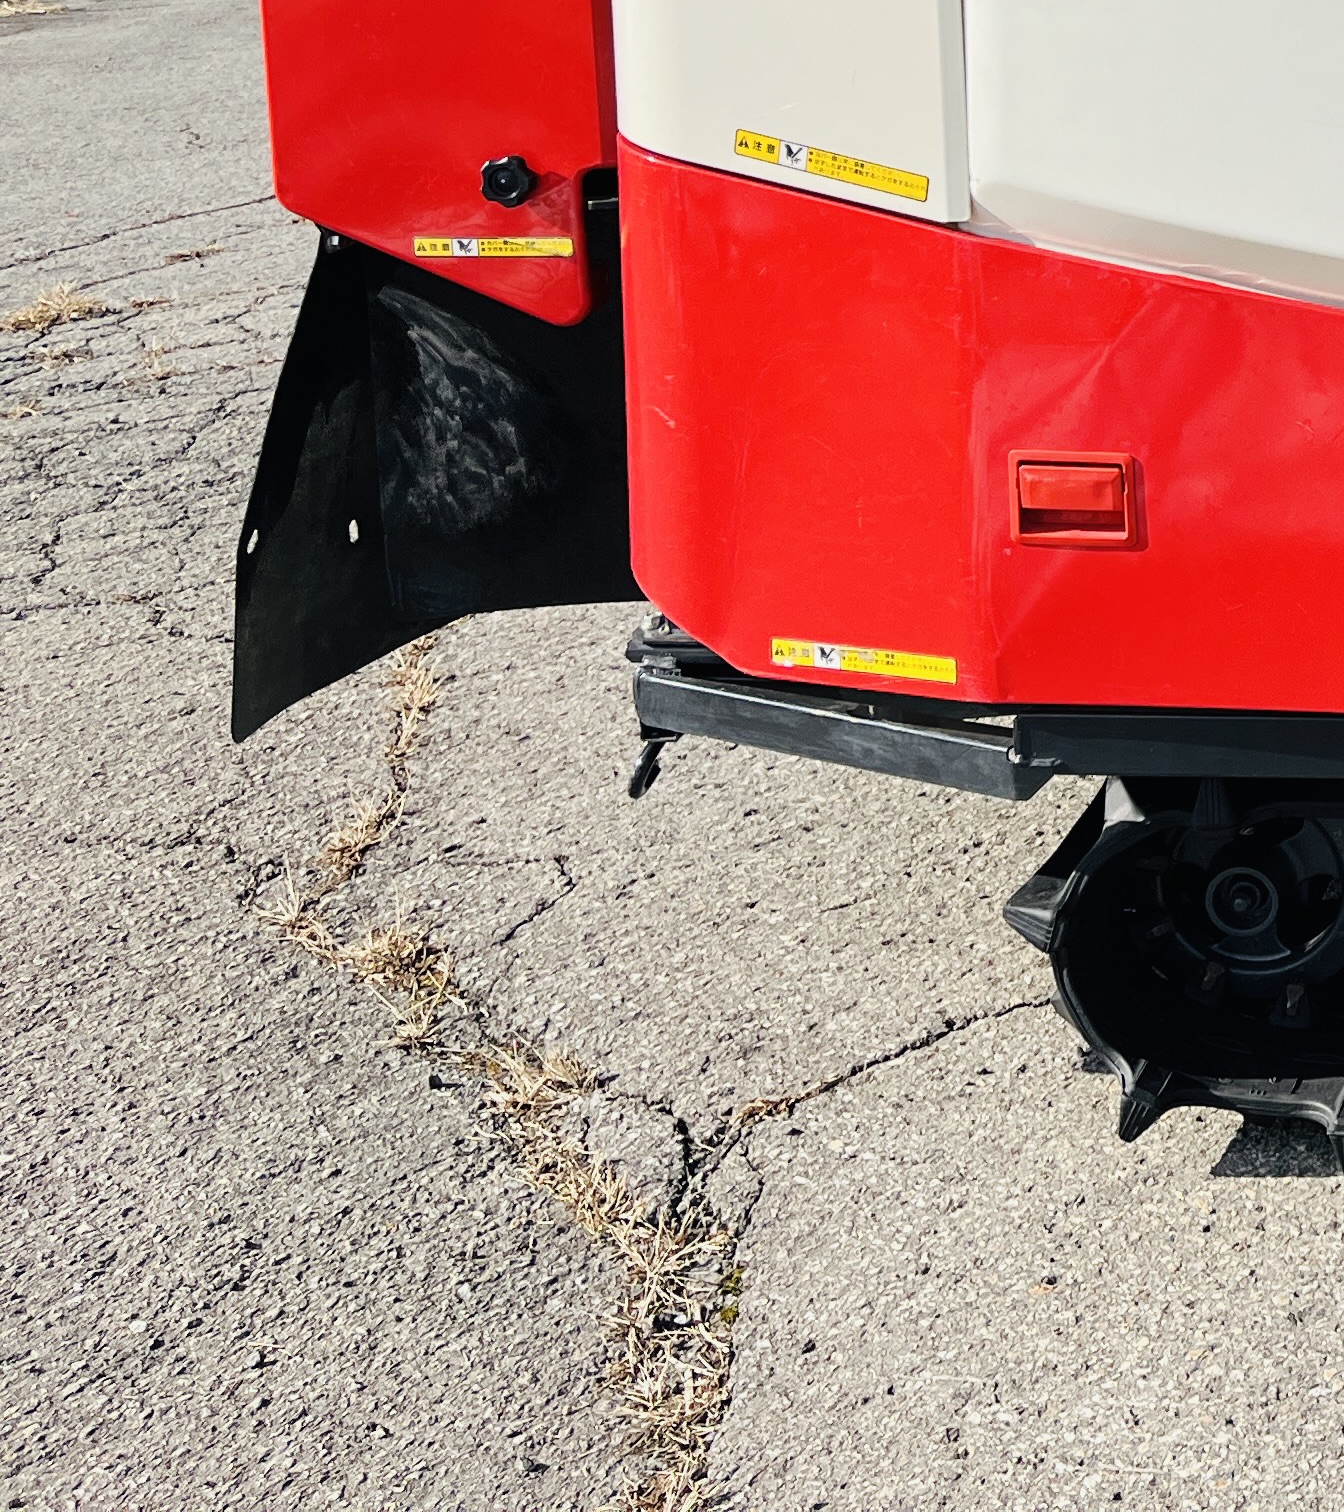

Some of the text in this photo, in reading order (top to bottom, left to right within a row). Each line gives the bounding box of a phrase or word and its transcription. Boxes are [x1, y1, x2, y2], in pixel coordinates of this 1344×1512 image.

[753, 140, 776, 155] 注意
[429, 243, 450, 251] 注意
[788, 647, 810, 658] 注意
